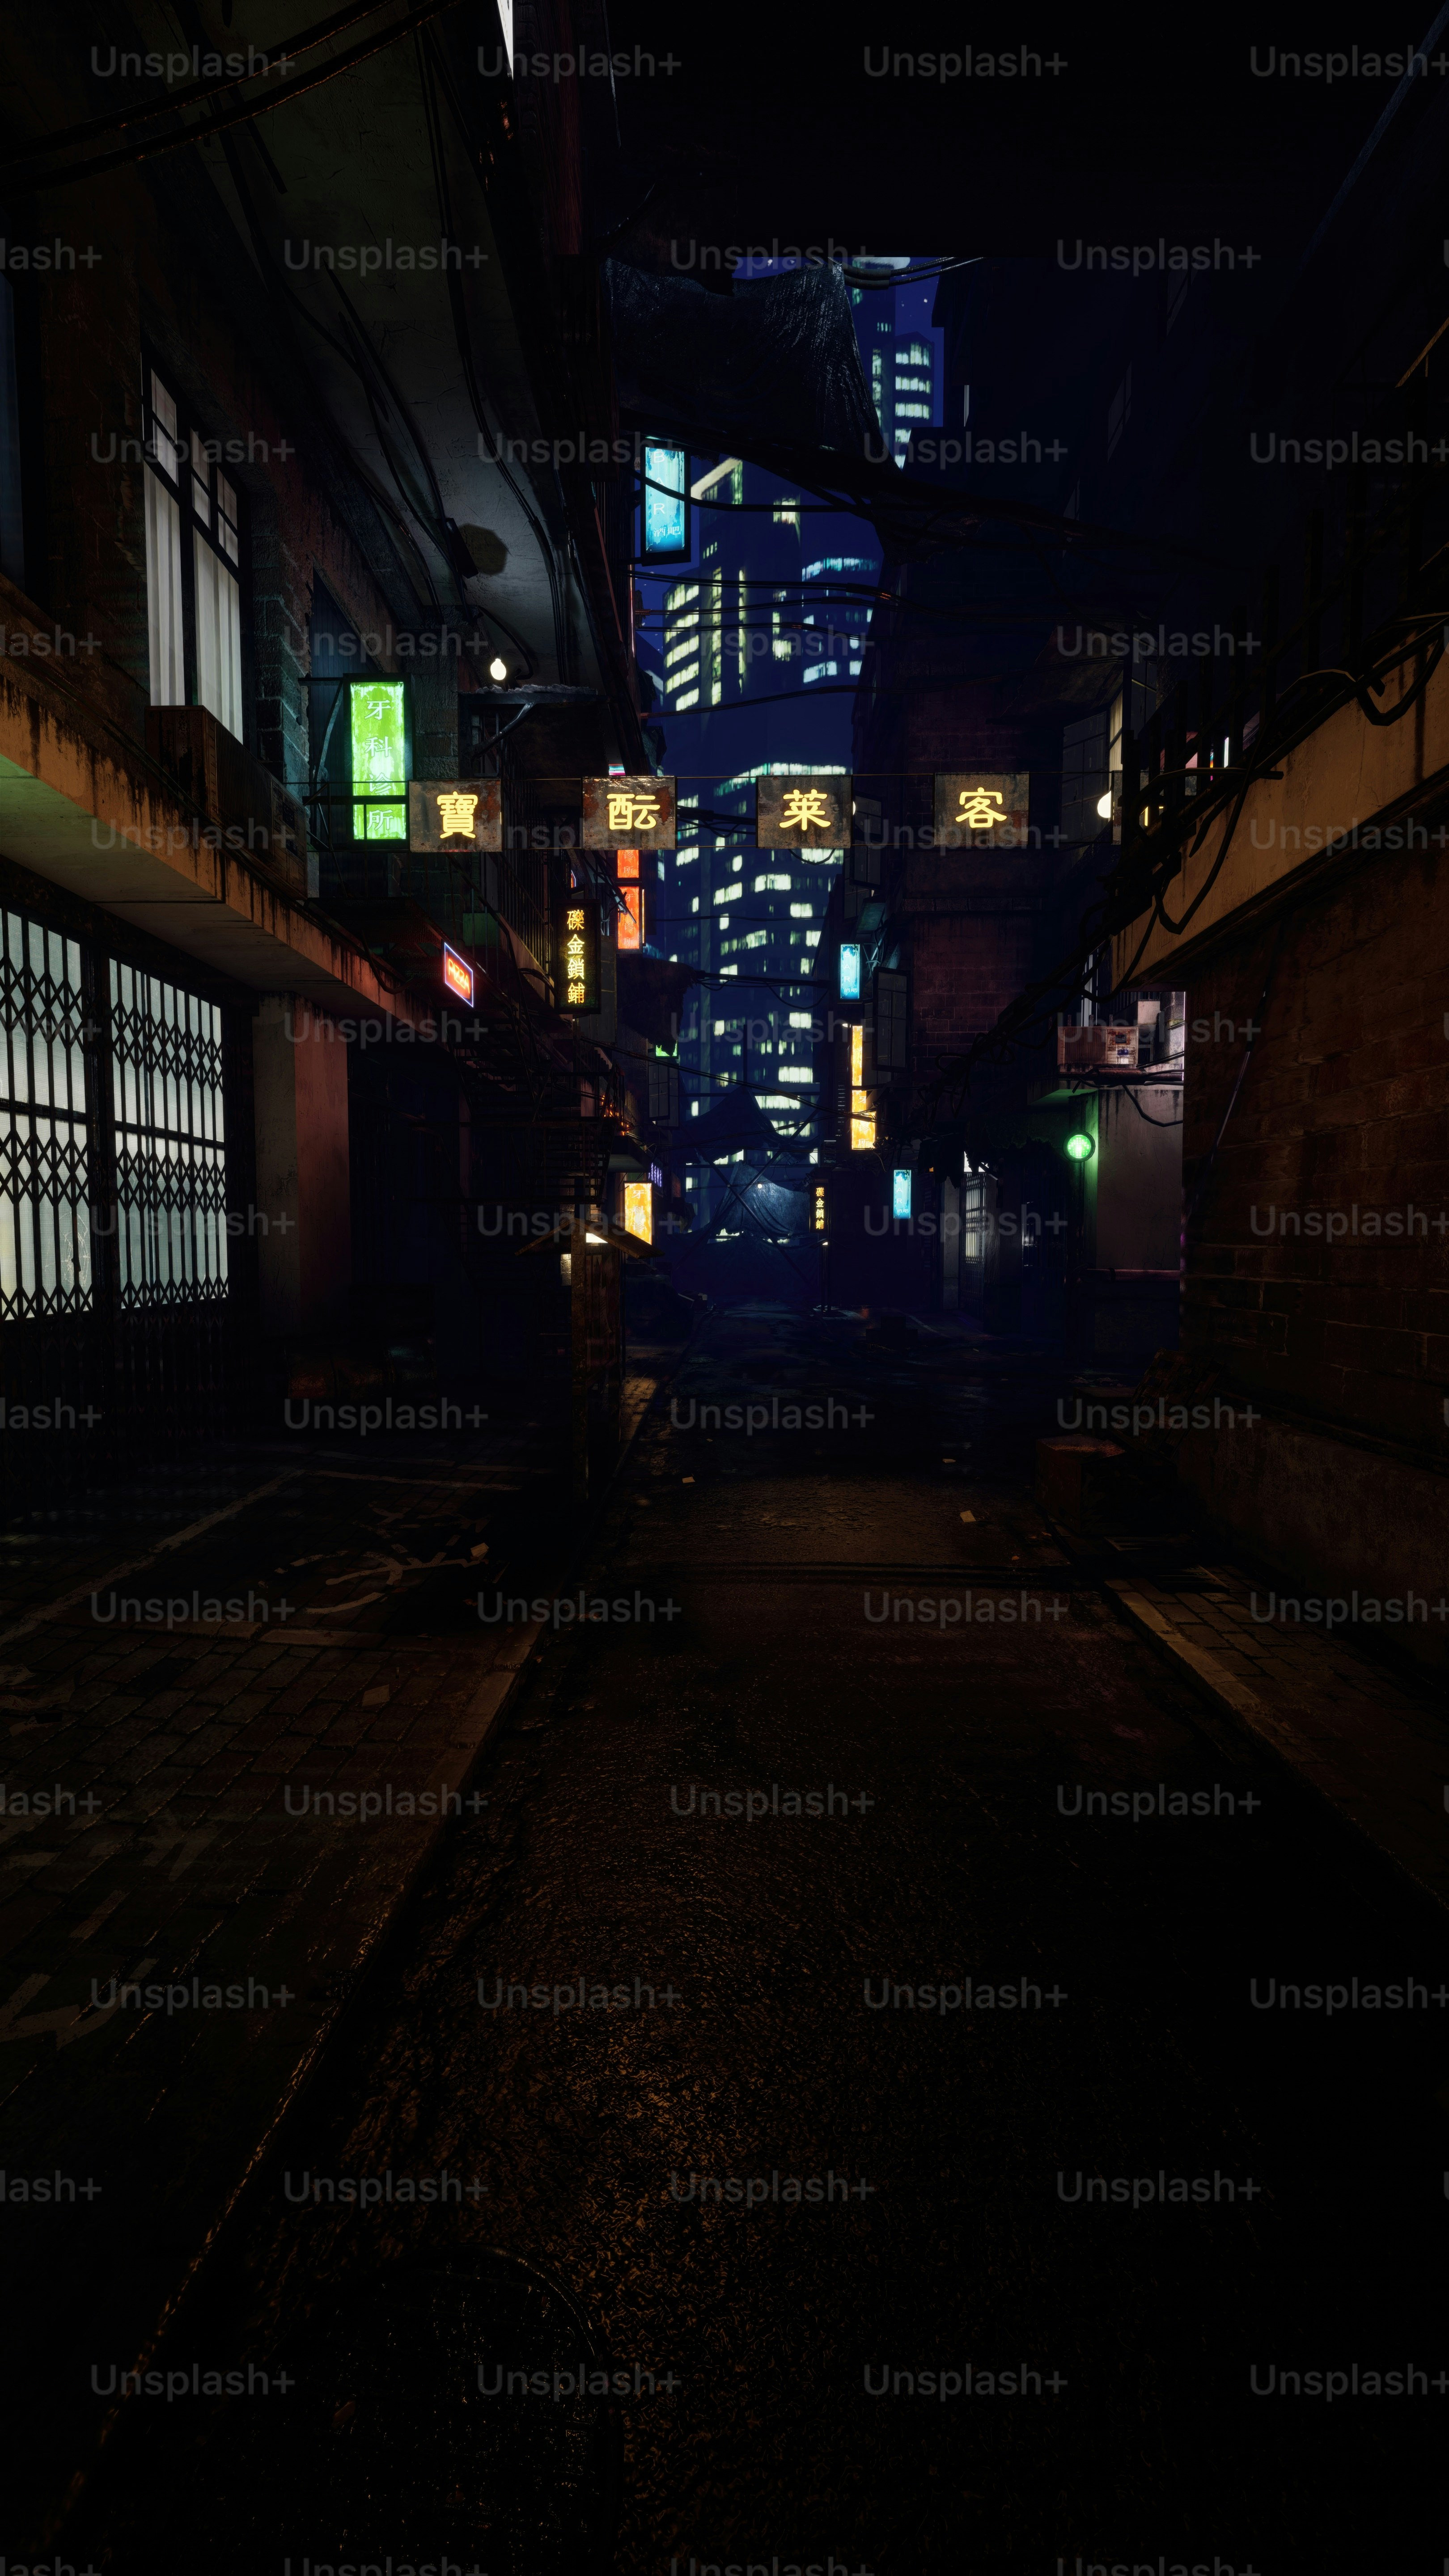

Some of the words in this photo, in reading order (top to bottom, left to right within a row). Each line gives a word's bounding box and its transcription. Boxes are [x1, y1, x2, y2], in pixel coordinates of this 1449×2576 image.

[654, 526, 680, 537] 酒吧
[364, 699, 394, 830] 牙科诊所
[437, 791, 478, 839] 寶
[607, 793, 660, 830] 酝
[955, 787, 1007, 828] 客
[448, 958, 470, 994] PIZZA
[632, 1190, 645, 1240] 牙科诊
